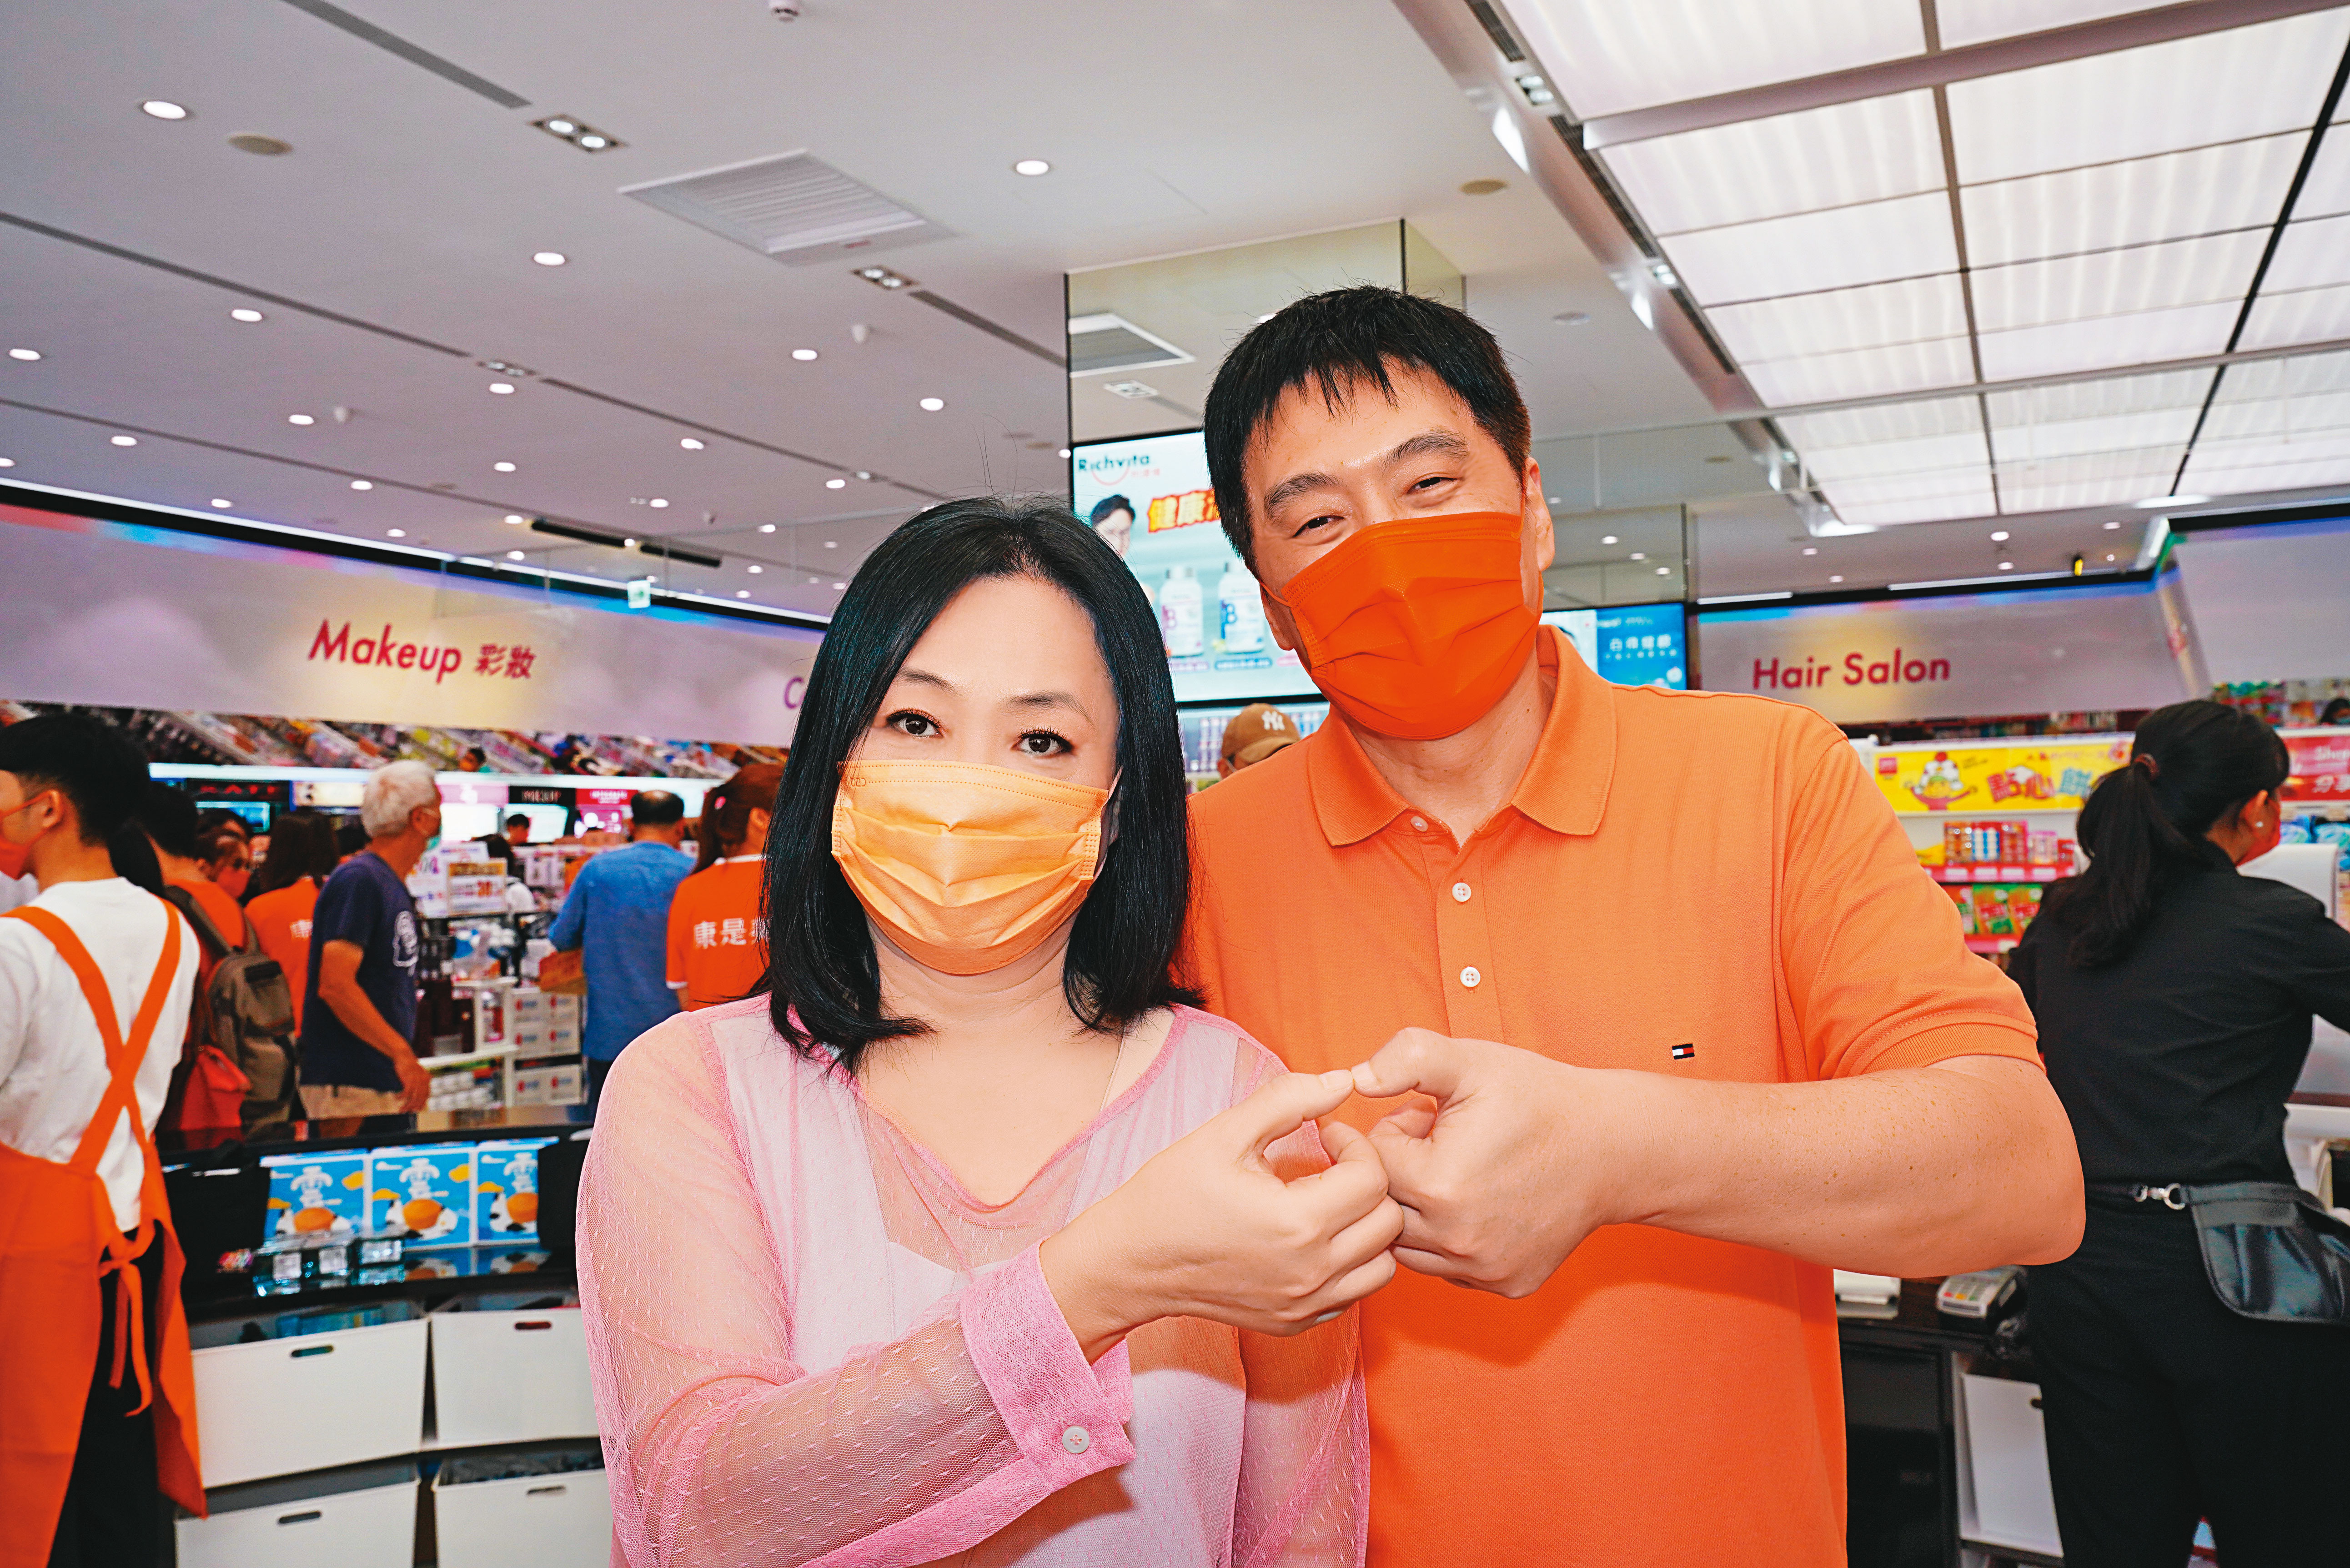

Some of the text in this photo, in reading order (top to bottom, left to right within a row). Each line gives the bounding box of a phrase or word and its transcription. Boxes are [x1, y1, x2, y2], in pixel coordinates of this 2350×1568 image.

[1078, 455, 1150, 472] Richvita
[307, 618, 462, 685] Makeup
[1752, 647, 1952, 690] Hair Salon
